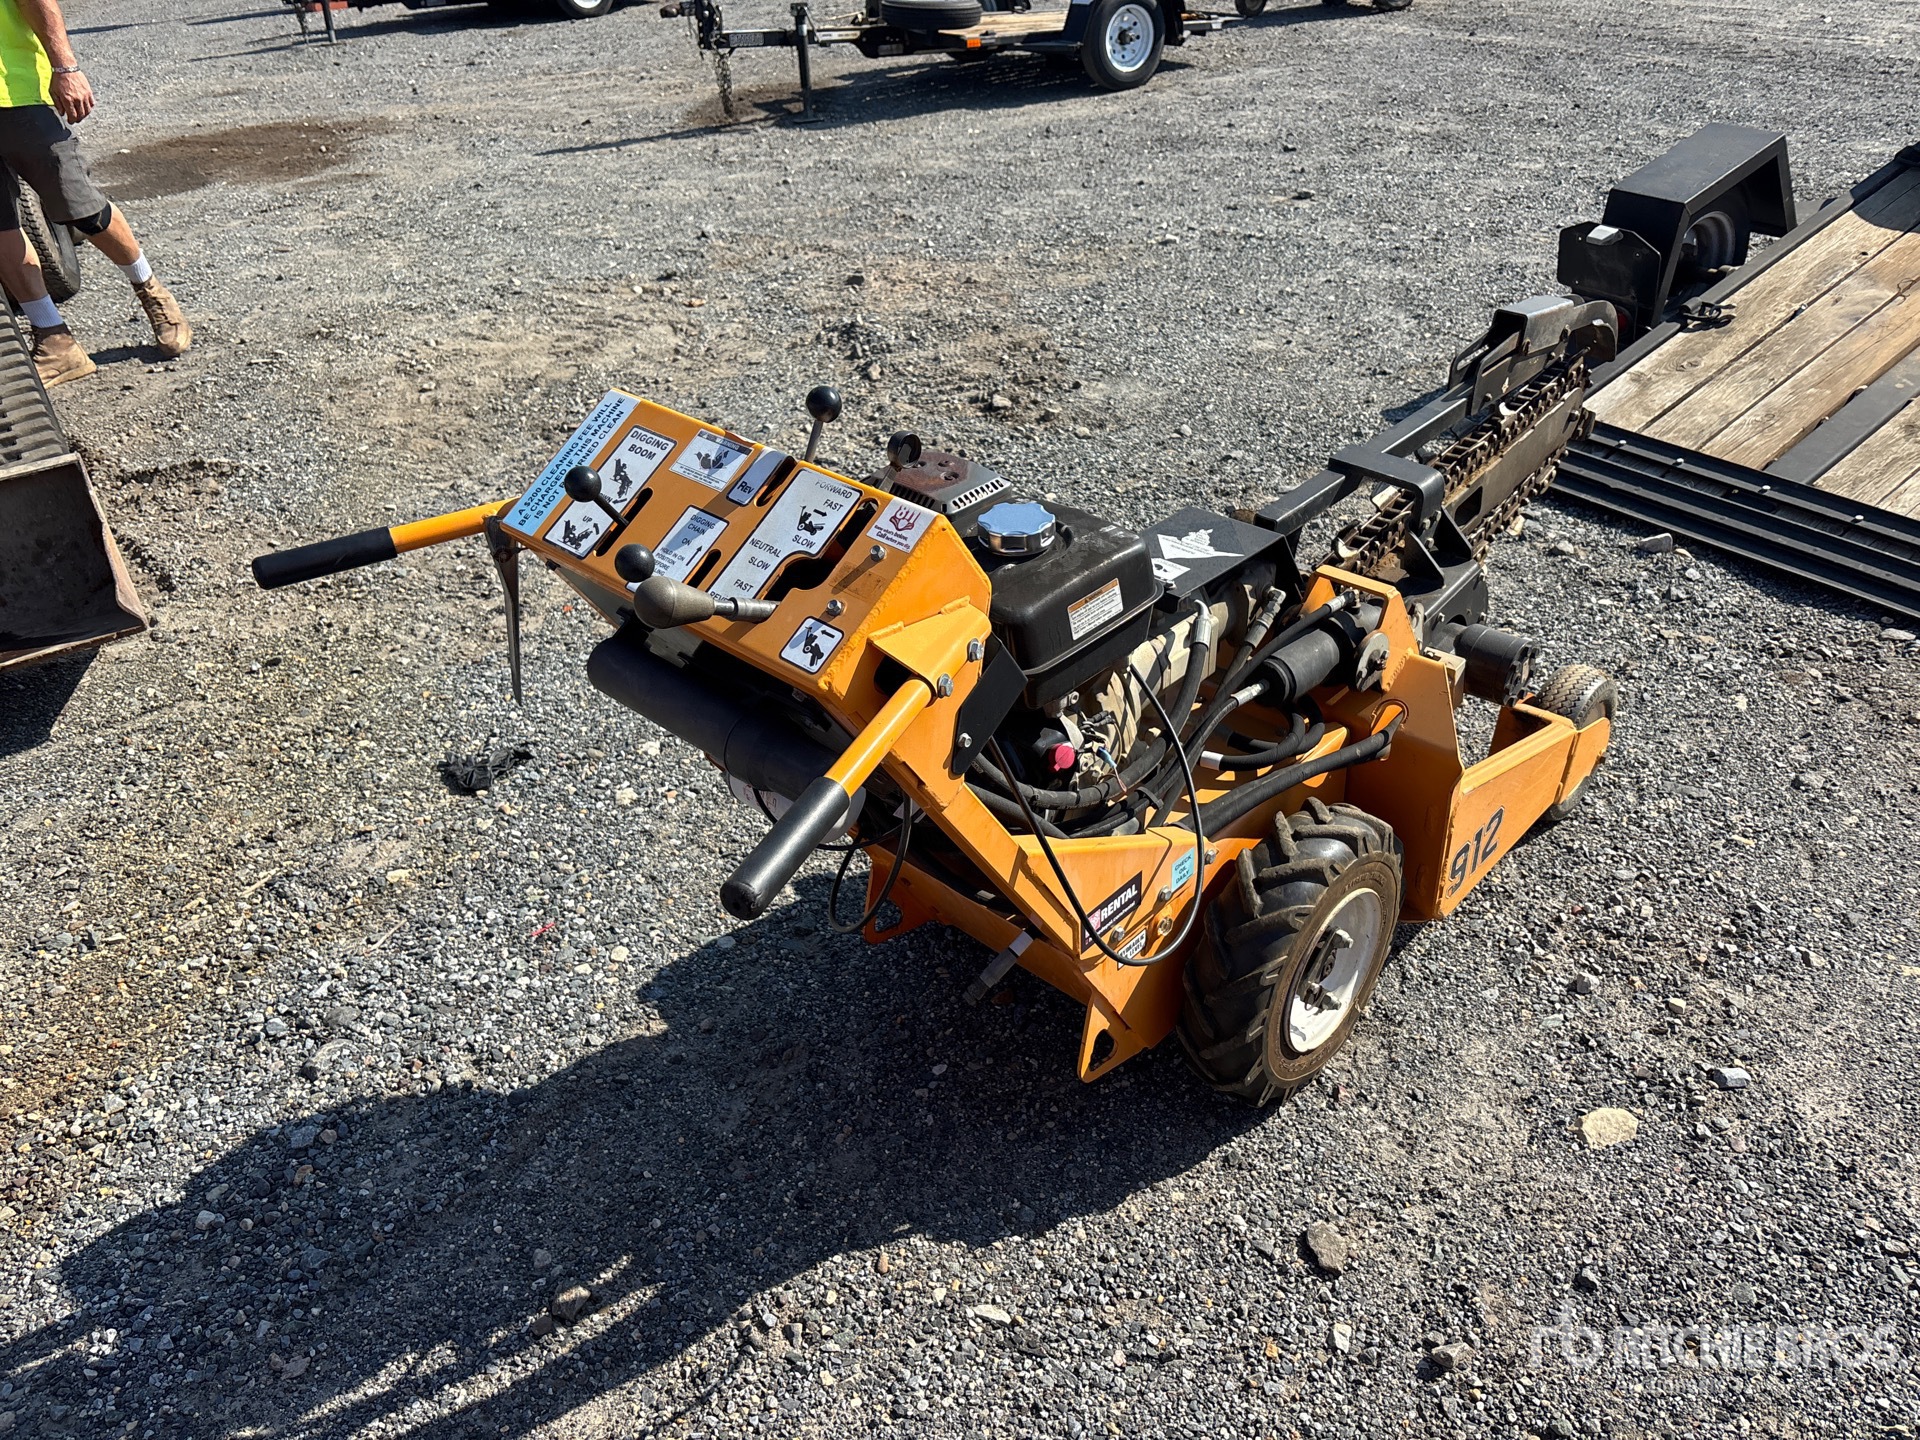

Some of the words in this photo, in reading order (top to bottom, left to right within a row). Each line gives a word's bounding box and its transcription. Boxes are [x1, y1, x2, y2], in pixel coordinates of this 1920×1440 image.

[630, 430, 669, 451] DIGGING
[524, 487, 542, 507] $200
[541, 442, 579, 486] CLEANING
[577, 423, 594, 441] FEE
[592, 402, 612, 423] WILL
[628, 443, 656, 460] BOOM
[518, 514, 531, 526] BE
[530, 468, 567, 512] CHARGED
[566, 459, 575, 468] IF
[574, 438, 592, 457] THIS
[591, 397, 625, 437] MACHINE
[534, 510, 544, 519] IS
[543, 490, 560, 509] NOT
[598, 410, 625, 440] CLEAN
[815, 481, 853, 499] FORWARD
[823, 499, 843, 512] FAST
[582, 515, 593, 523] UP
[690, 514, 716, 529] DIGGING
[687, 523, 706, 535] CHAIN
[681, 537, 692, 546] ON
[749, 537, 782, 558] NEUTRAL
[792, 534, 816, 549] SLOW
[655, 552, 676, 565] POSITION
[748, 556, 771, 571] SLOW
[733, 578, 754, 592] FAST
[1446, 805, 1505, 899] 912
[1174, 854, 1191, 871] CHECK
[1178, 865, 1187, 874] OIL
[1175, 869, 1190, 884] DAILY
[1101, 884, 1138, 921] RENTAL
